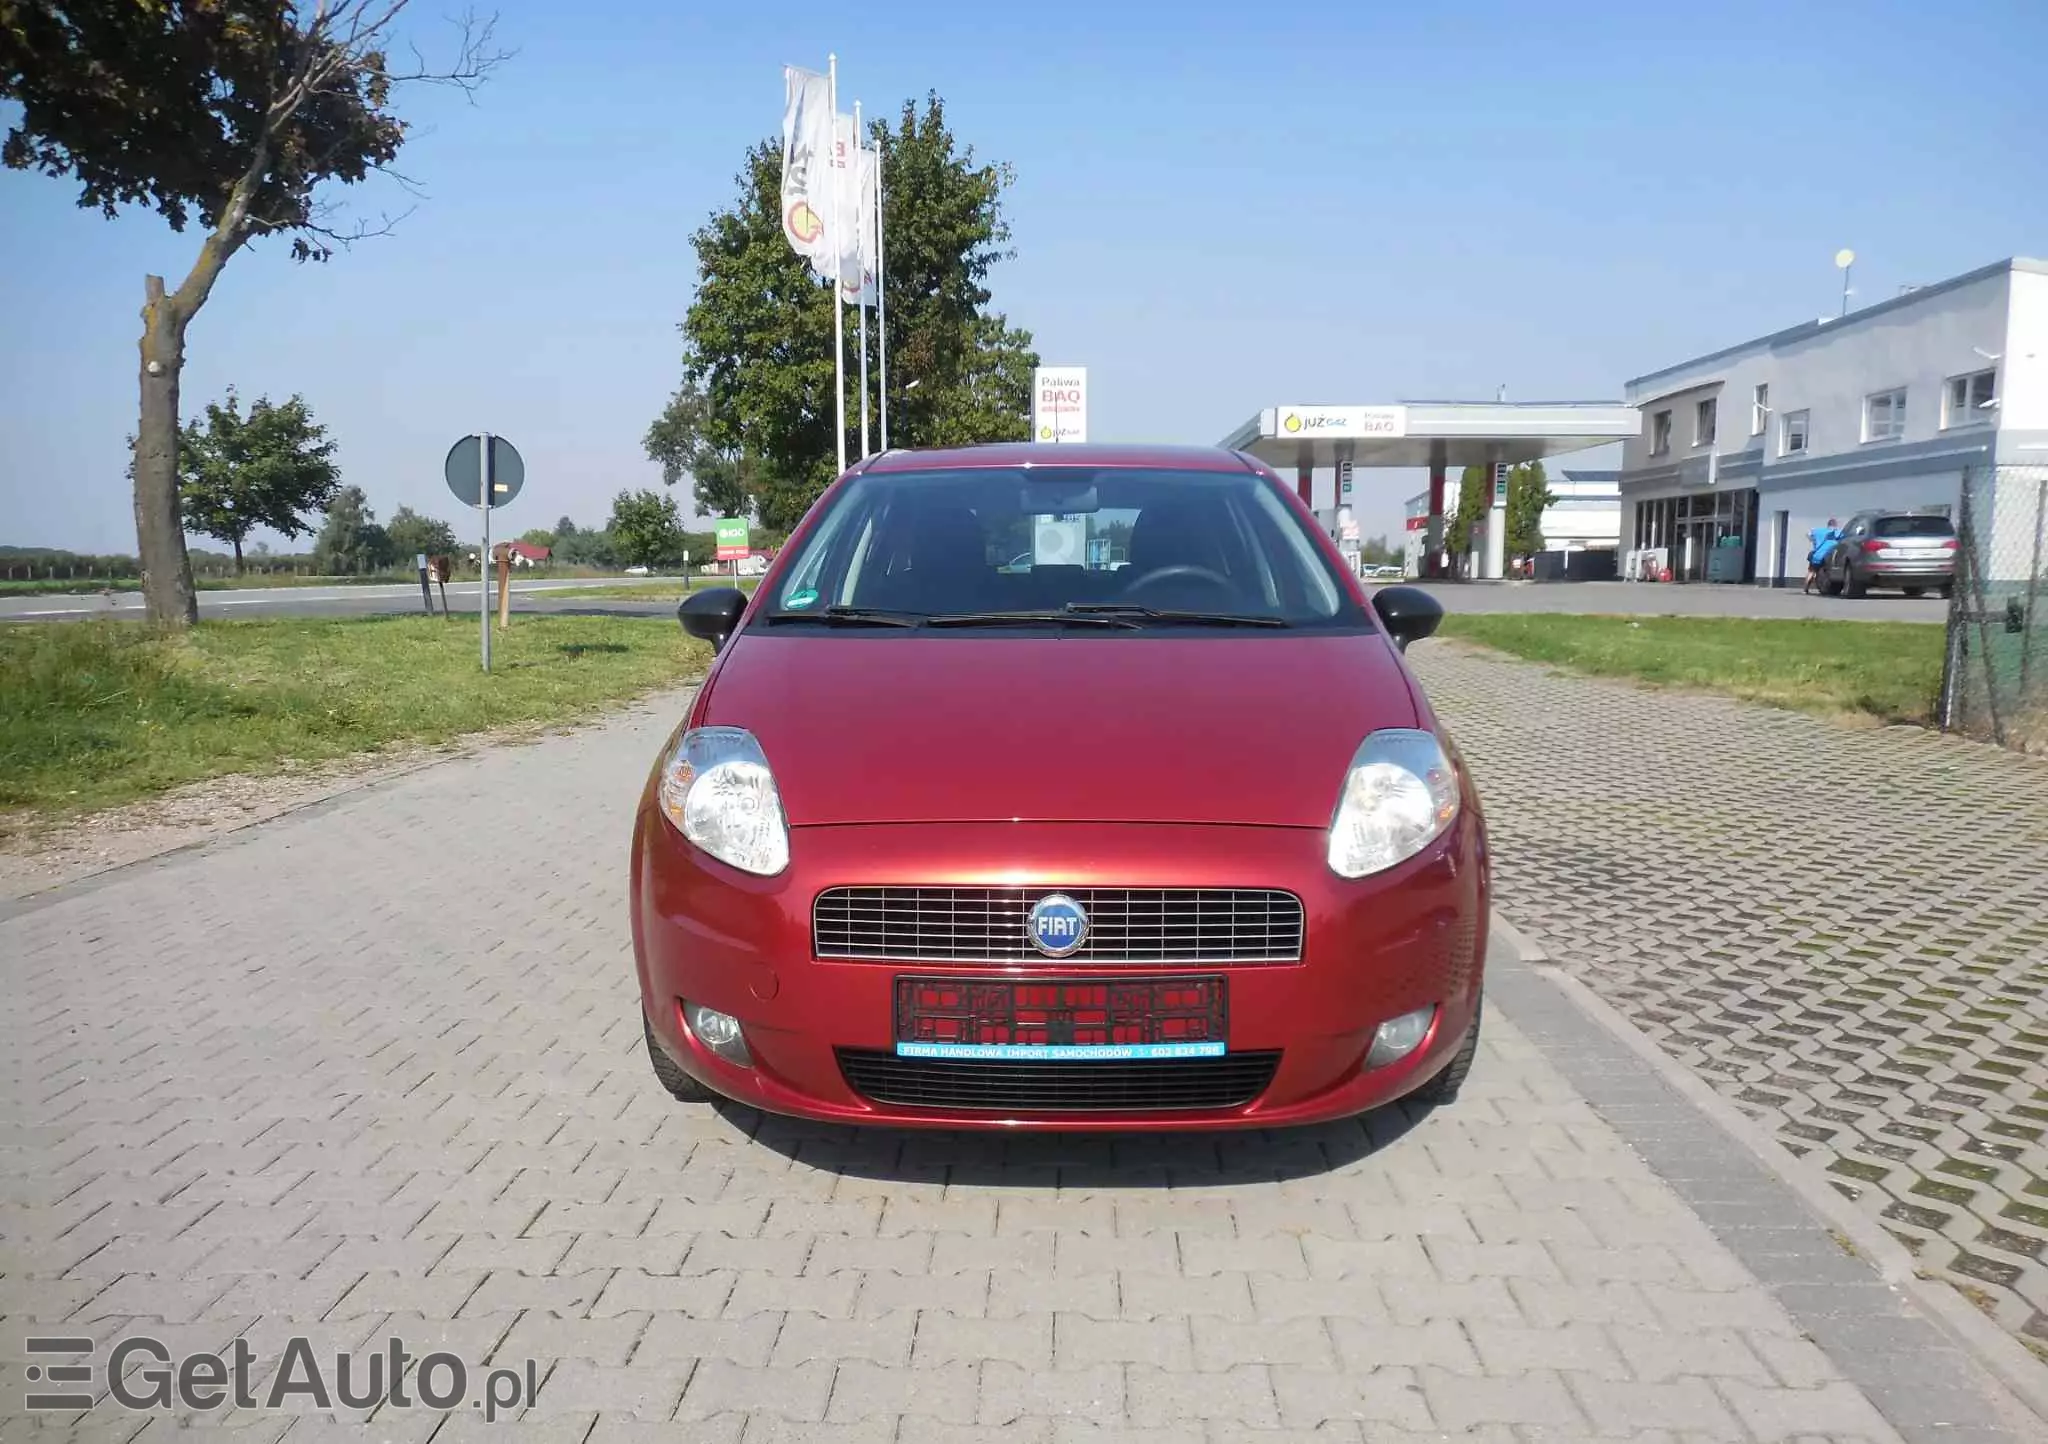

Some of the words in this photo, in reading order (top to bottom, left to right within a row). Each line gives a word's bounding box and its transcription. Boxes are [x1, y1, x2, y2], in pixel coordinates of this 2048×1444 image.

[1042, 376, 1080, 387] Paliwa
[1042, 390, 1081, 404] BAQ
[1038, 916, 1077, 936] FIAT
[903, 1046, 938, 1056] FIRMA
[940, 1046, 1001, 1057] HANDLOWA
[1007, 1047, 1048, 1058] IMPORT
